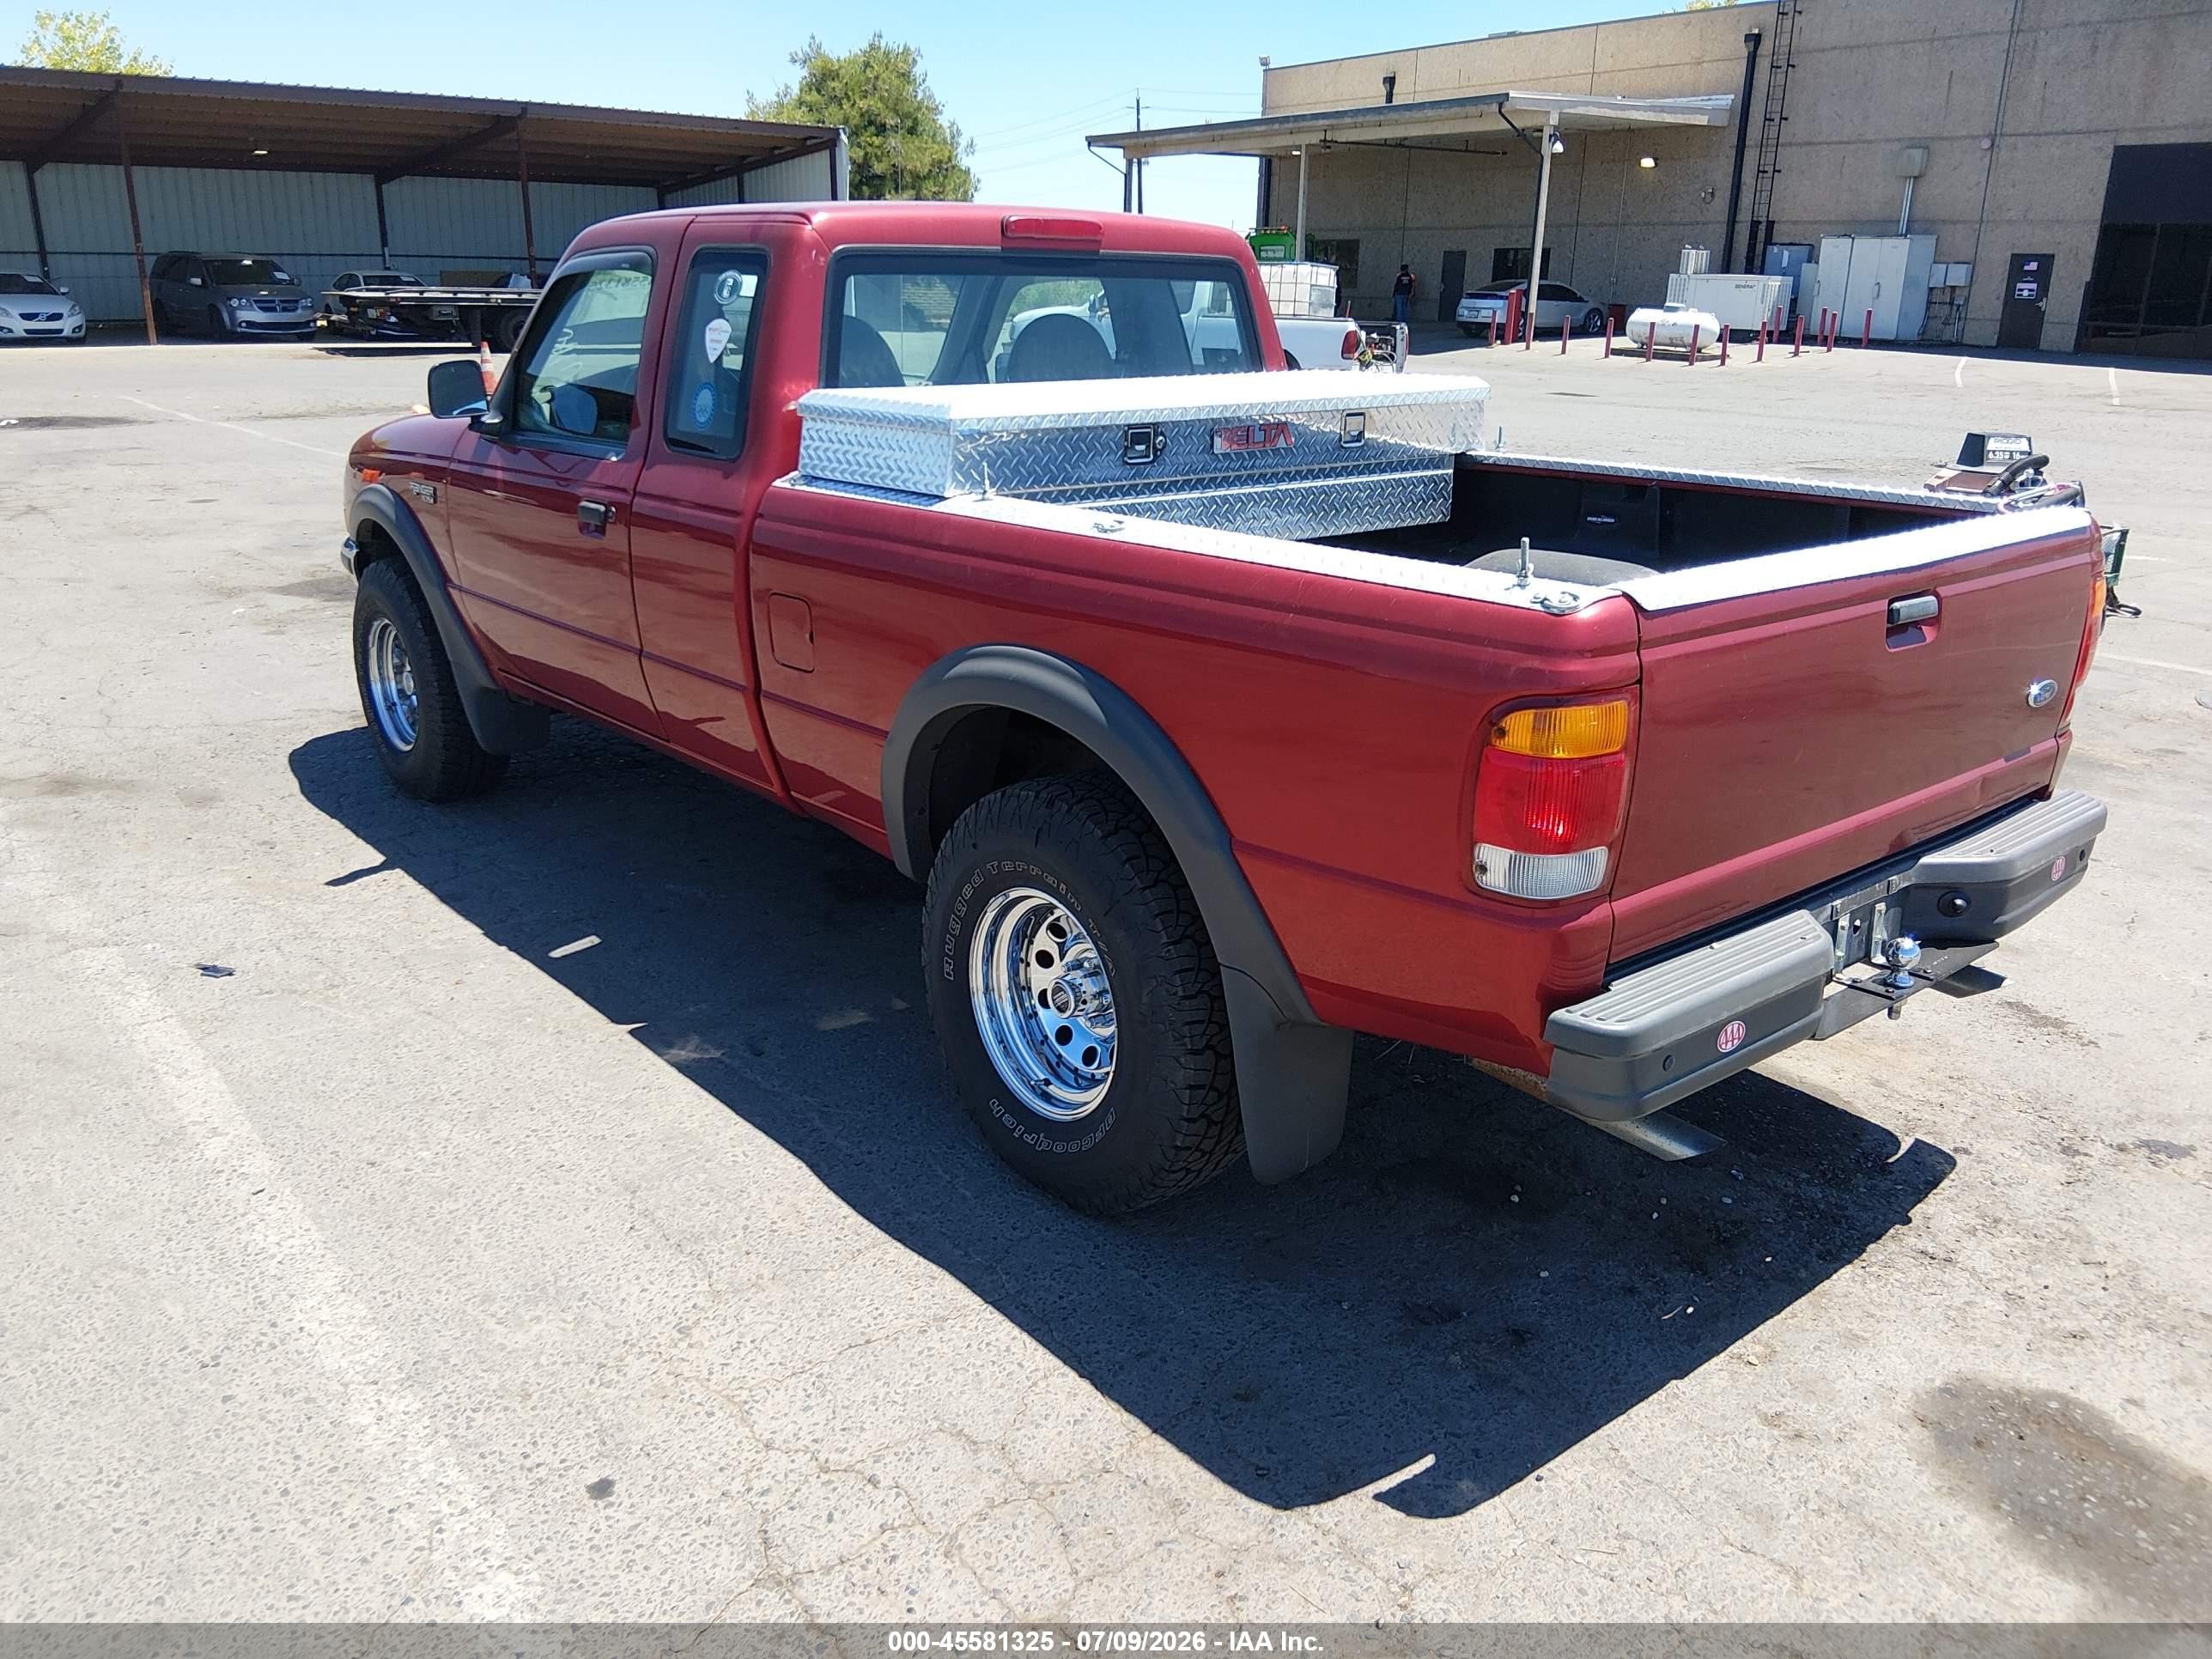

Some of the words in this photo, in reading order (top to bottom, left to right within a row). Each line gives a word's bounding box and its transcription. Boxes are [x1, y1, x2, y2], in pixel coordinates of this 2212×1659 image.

[1216, 422, 1293, 451] DELTA
[944, 869, 985, 981] Rugged
[987, 860, 1082, 912] Terrain
